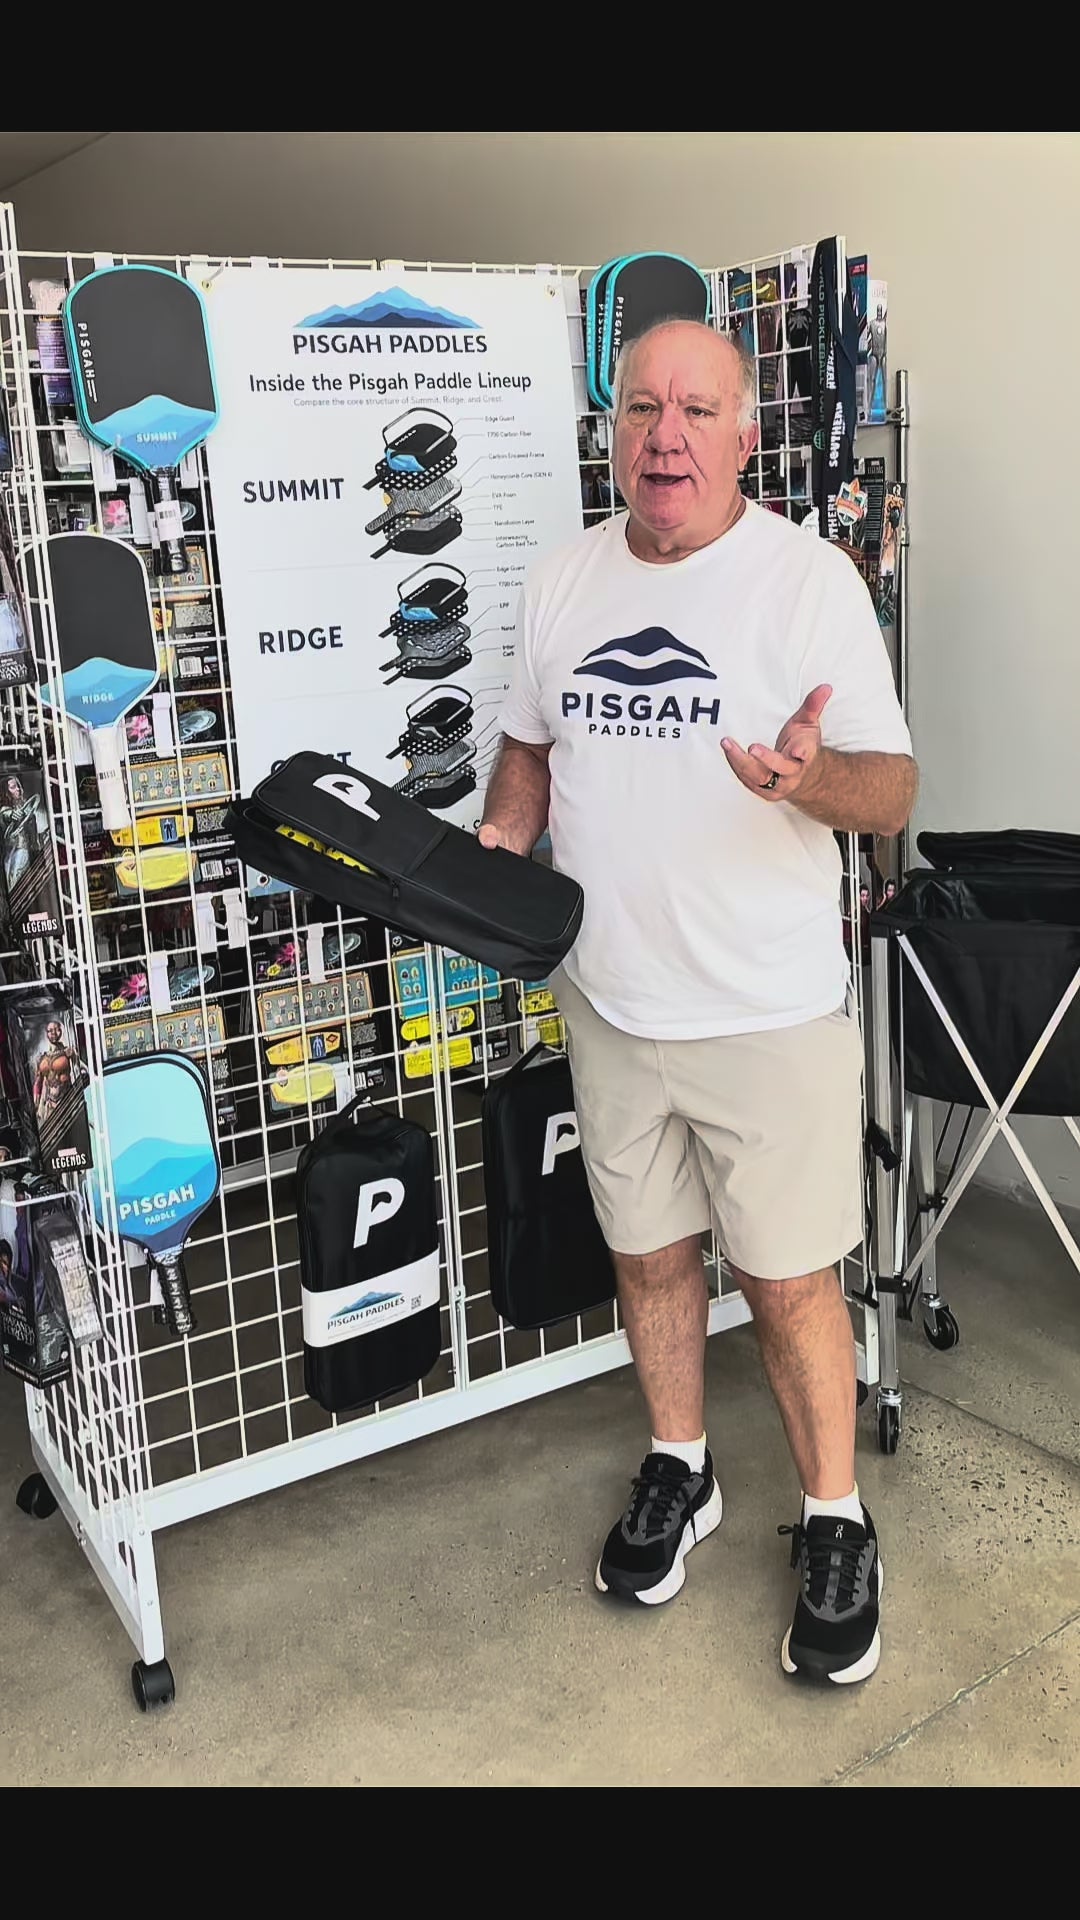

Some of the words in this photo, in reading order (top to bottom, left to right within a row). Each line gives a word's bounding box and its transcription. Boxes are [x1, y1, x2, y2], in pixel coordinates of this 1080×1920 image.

[613, 296, 624, 345] PISGAH
[78, 322, 95, 379] PISGAH
[293, 334, 382, 354] PISGAH
[389, 334, 487, 353] PADDLES
[249, 374, 305, 392] Inside
[312, 373, 342, 391] the
[349, 372, 408, 395] Pisgah
[414, 371, 472, 390] Paddle
[478, 371, 532, 392] Lineup
[293, 398, 330, 408] Compare
[332, 397, 345, 406] the
[366, 397, 400, 406] structure
[402, 396, 409, 404] of
[467, 396, 481, 404] and
[485, 415, 498, 423] Edge
[136, 431, 178, 443] SUMMIT
[243, 478, 344, 503] SUMMIT
[259, 626, 343, 655] RIDGE
[81, 692, 114, 705] RIDGE
[562, 692, 721, 725] PISGAH
[589, 723, 681, 738] PADDLES
[312, 773, 381, 822] P
[22, 918, 58, 934] LEGENDS
[51, 1153, 87, 1169] LEGENDS
[119, 1183, 195, 1220] PISGAH
[353, 1177, 405, 1249] P
[144, 1209, 176, 1225] PADDLE
[327, 1312, 363, 1330] PISGAH
[365, 1296, 405, 1317] PADDLES
